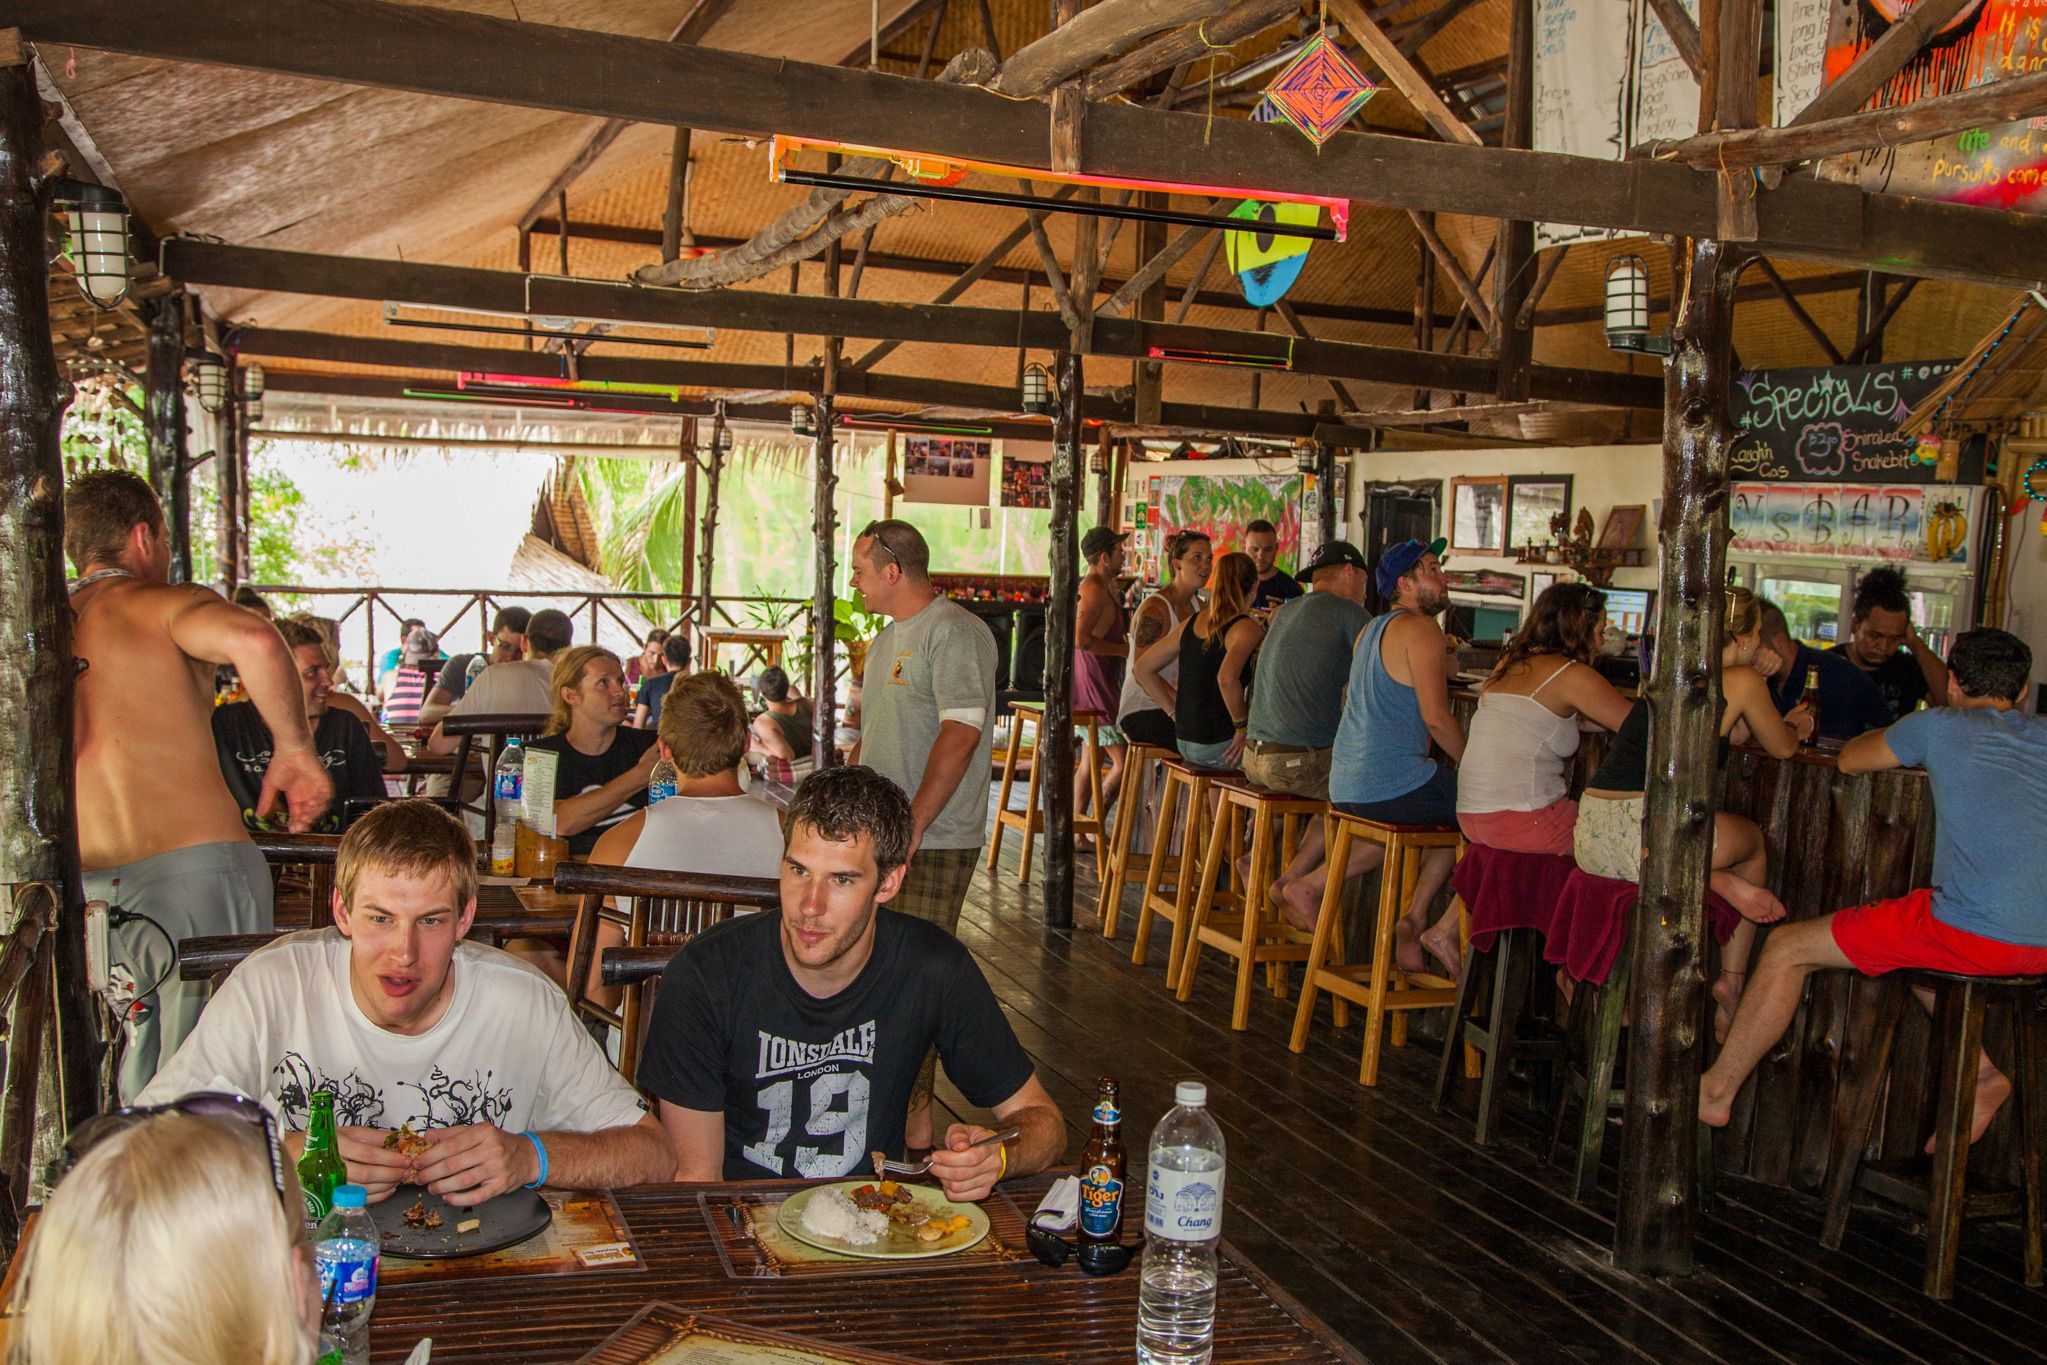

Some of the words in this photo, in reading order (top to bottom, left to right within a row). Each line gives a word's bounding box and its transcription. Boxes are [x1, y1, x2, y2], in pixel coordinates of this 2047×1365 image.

[1958, 127, 1991, 161] life
[2000, 131, 2033, 156] and
[1933, 155, 2001, 187] pursuits
[755, 1019, 876, 1079] LONSDALE
[797, 1063, 840, 1080] LONDON
[743, 1070, 870, 1179] 19
[1081, 1183, 1119, 1208] Tiger
[1177, 1215, 1213, 1229] Chang
